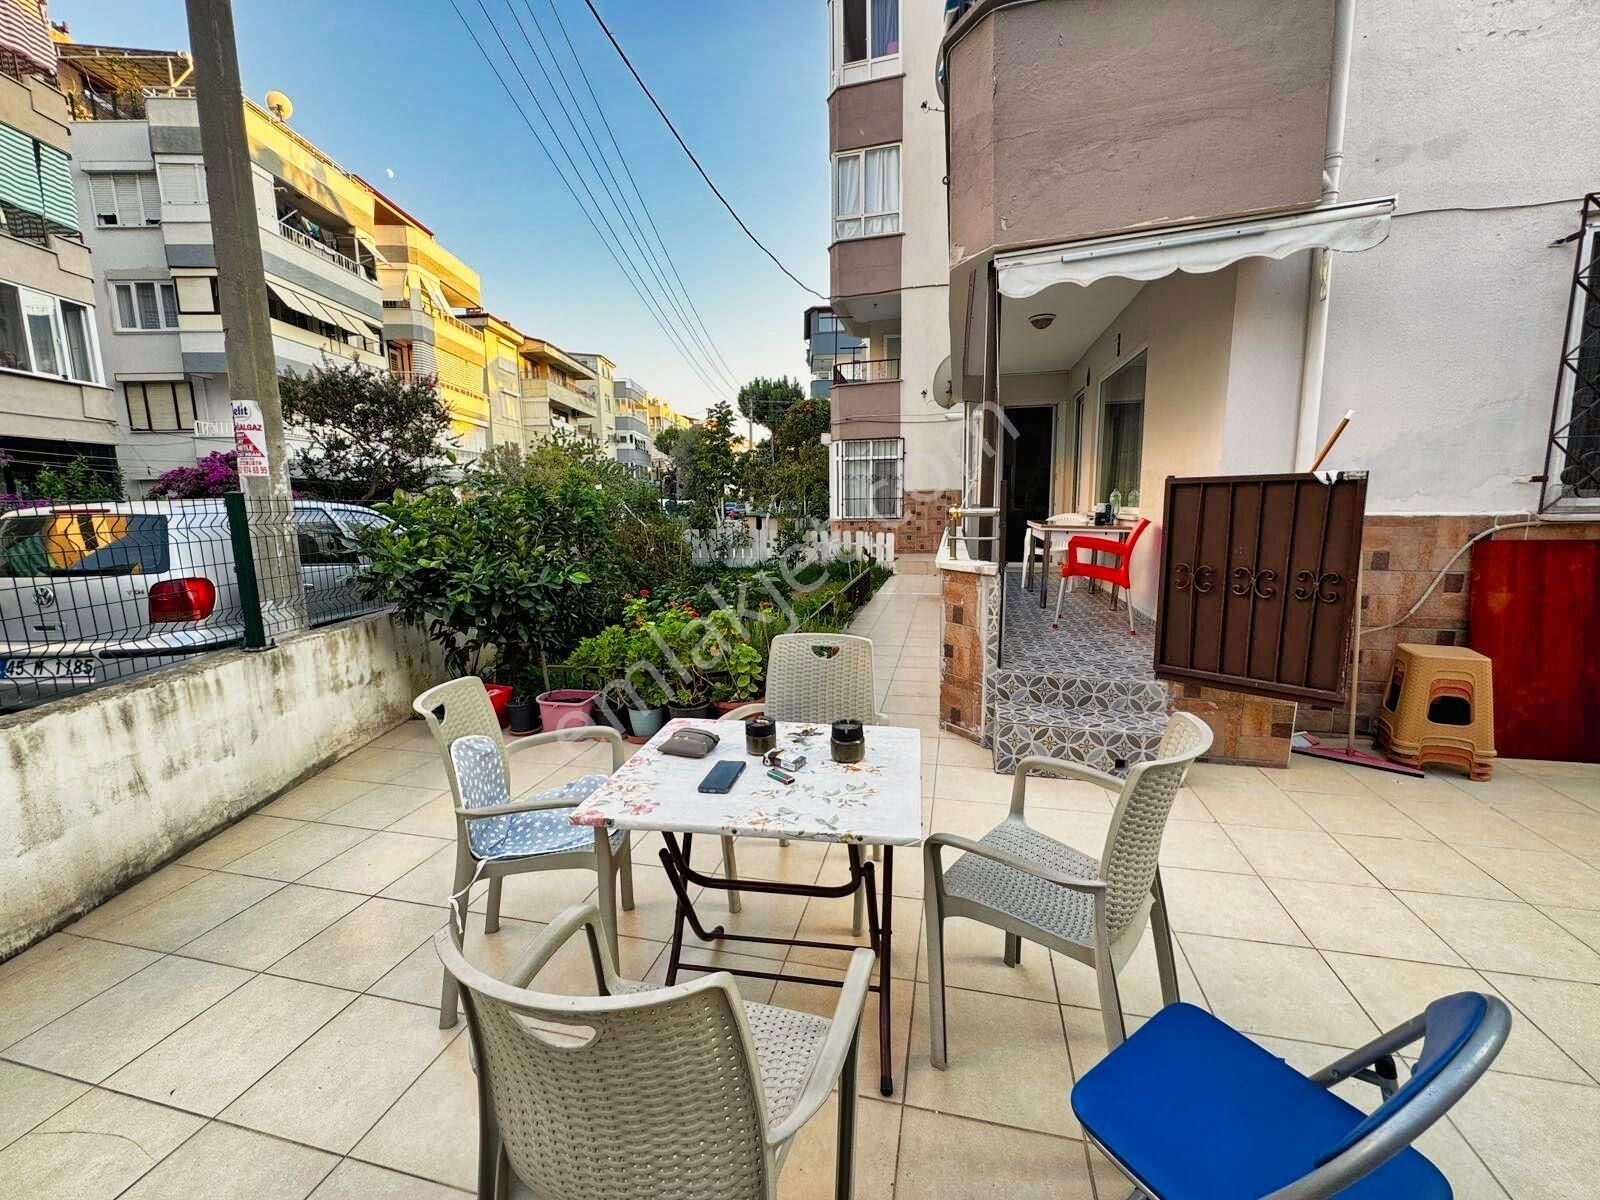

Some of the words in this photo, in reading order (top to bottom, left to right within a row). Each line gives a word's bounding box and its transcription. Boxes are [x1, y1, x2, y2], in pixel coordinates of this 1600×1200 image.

[233, 405, 248, 416] elit
[6, 660, 25, 676] 45
[33, 660, 44, 675] M
[55, 659, 94, 675] 1185
